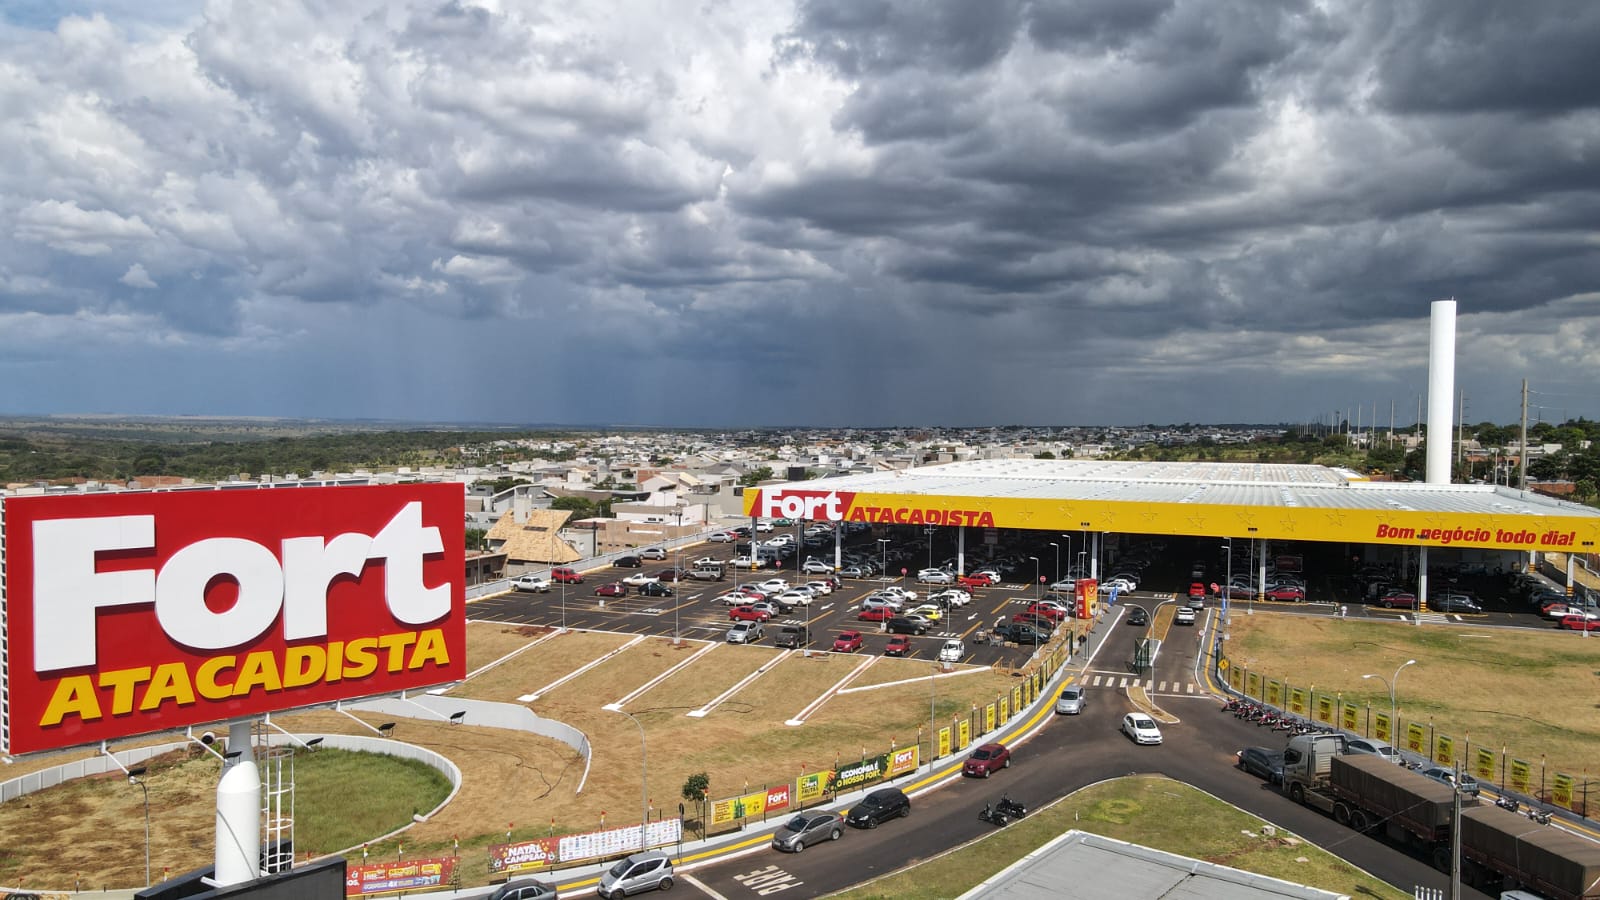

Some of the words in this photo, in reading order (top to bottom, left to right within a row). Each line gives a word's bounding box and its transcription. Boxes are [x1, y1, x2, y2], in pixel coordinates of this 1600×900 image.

[761, 488, 844, 521] Fort
[850, 506, 995, 528] ATACADISTA
[1376, 524, 1415, 539] Bom
[1420, 526, 1491, 544] negócio
[1495, 528, 1536, 545] todo
[1540, 530, 1576, 546] dia!
[32, 501, 451, 673] Fort
[39, 628, 450, 727] ATACADISTA
[894, 751, 913, 764] Fort
[841, 763, 875, 779] ECONOMIA
[843, 773, 865, 786] NOSSO
[768, 791, 788, 804] Fort
[508, 843, 543, 857] NATAL
[733, 864, 804, 896] PARE
